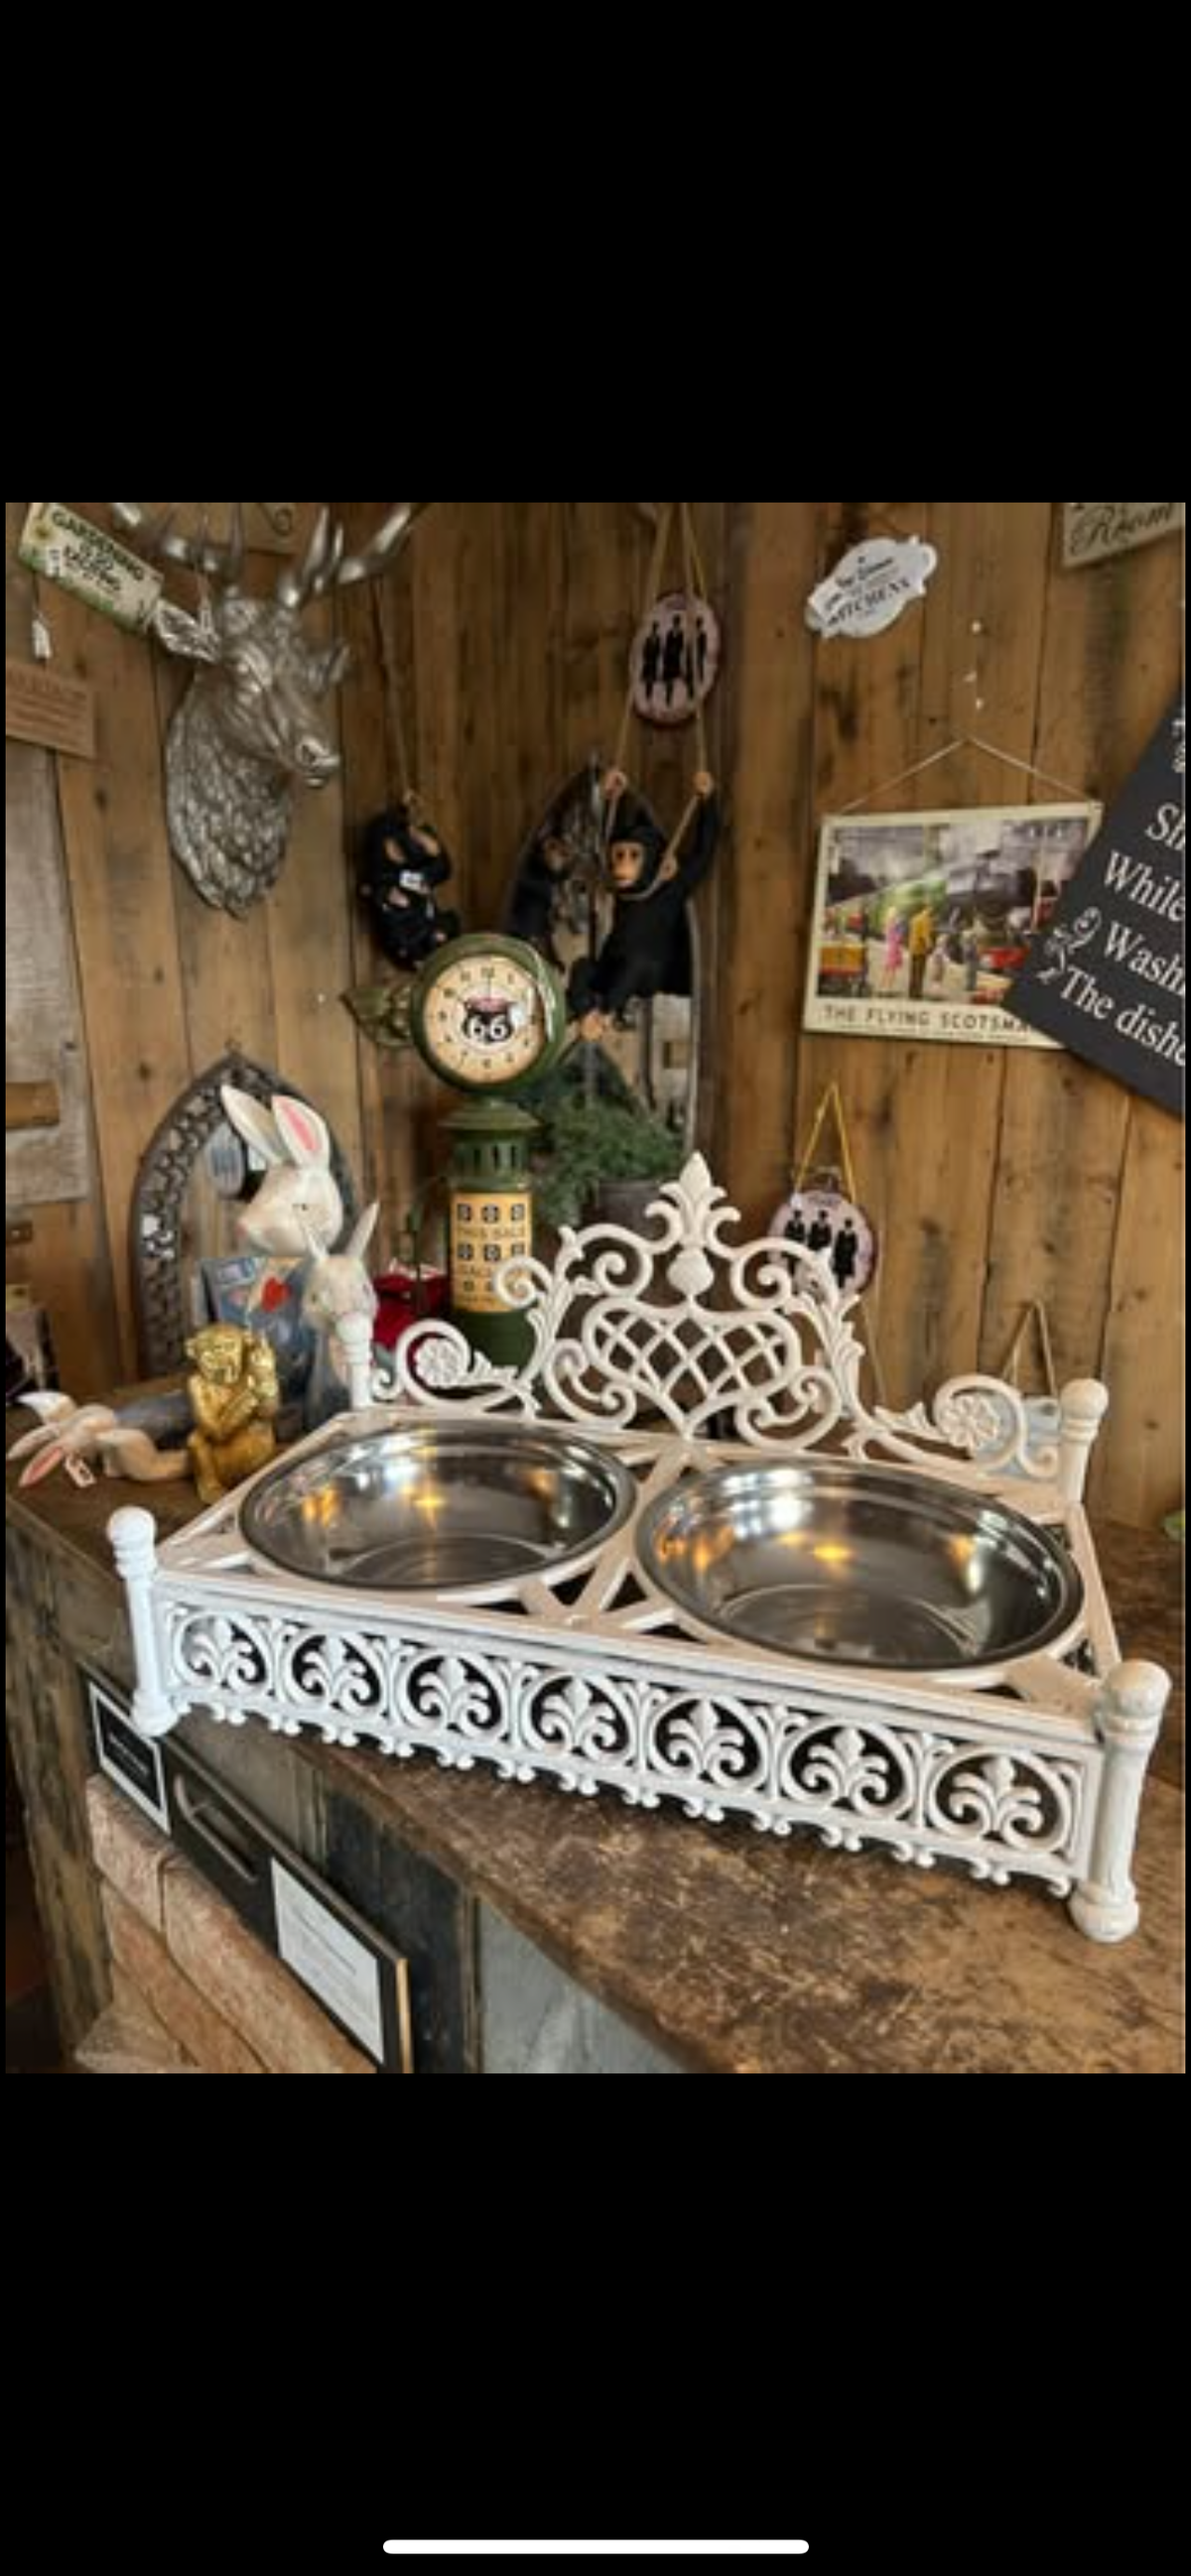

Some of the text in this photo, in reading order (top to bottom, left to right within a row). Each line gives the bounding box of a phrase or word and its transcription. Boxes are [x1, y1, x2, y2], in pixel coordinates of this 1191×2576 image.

[1104, 849, 1185, 923] While
[1104, 920, 1185, 996] Wash
[823, 1004, 857, 1023] THE
[865, 1007, 930, 1026] FLYING
[1060, 965, 1115, 1020] The
[468, 1013, 508, 1042] 66
